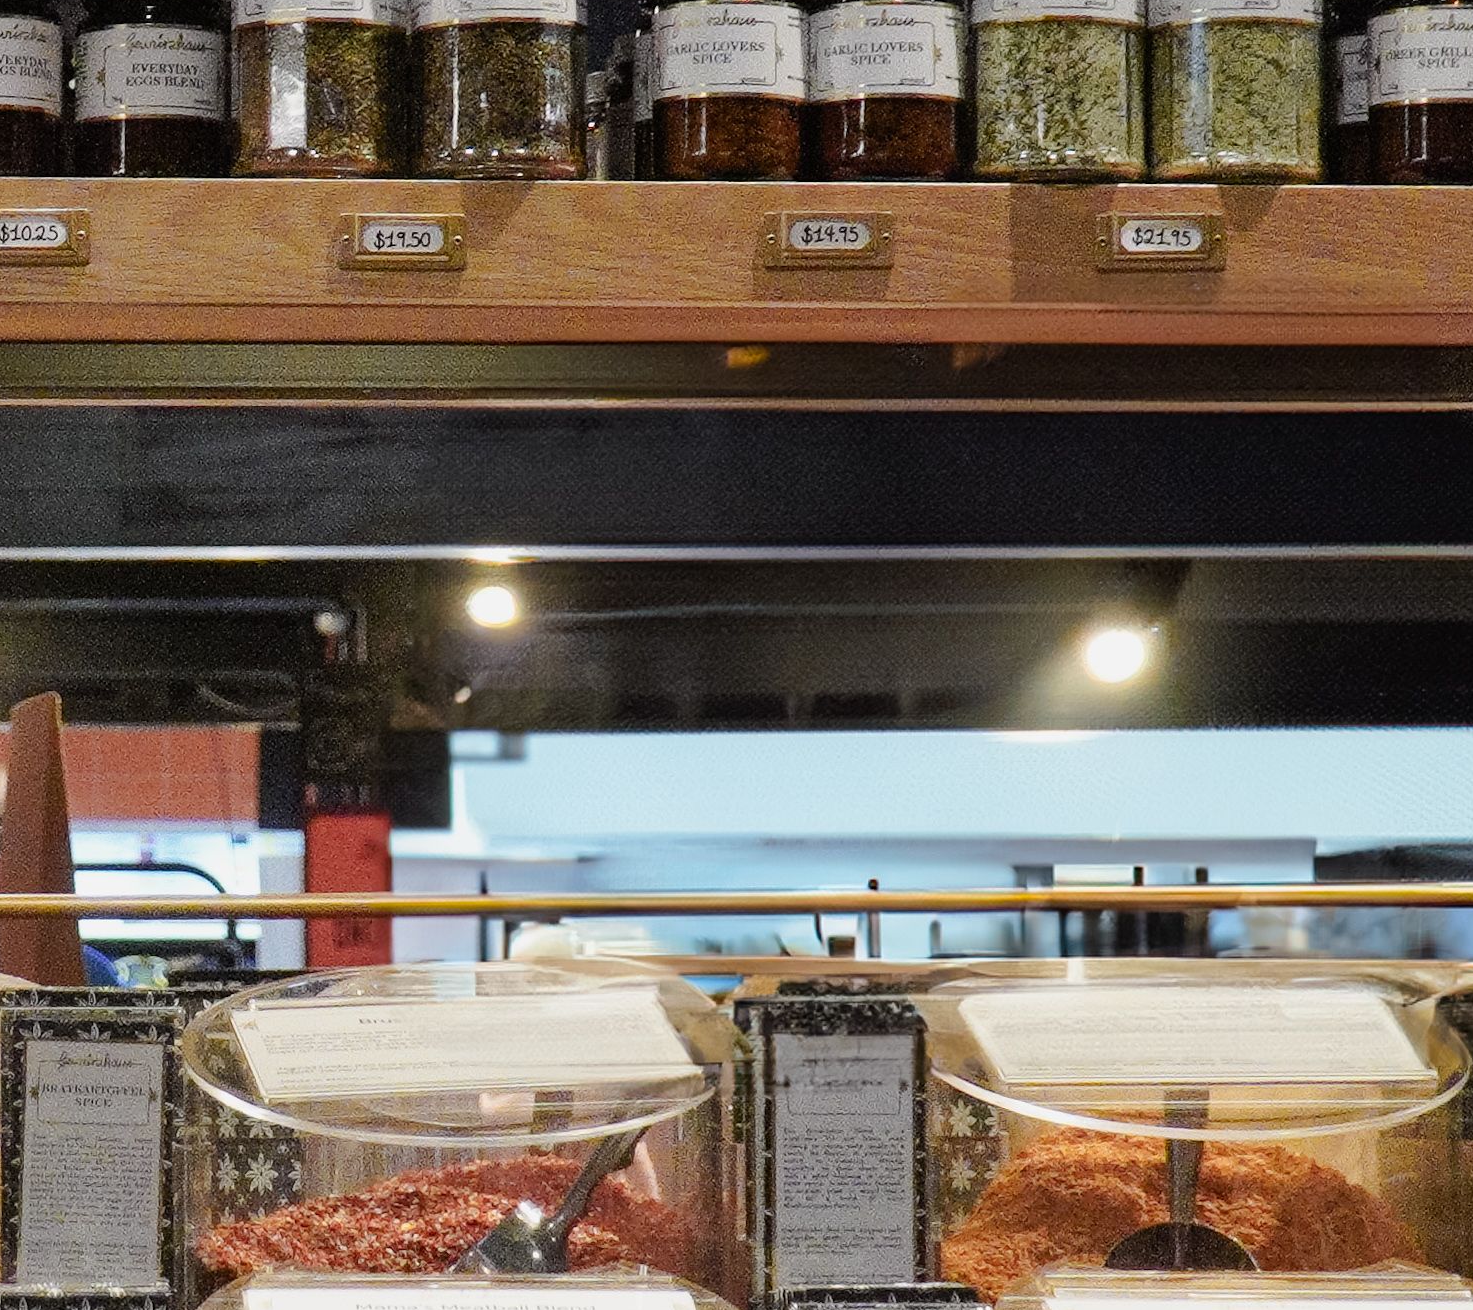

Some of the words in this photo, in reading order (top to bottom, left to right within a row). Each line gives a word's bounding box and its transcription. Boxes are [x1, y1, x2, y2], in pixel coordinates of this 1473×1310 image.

[712, 42, 766, 56] LOVERS
[691, 53, 733, 65] SPICE
[372, 232, 431, 250] $19.50
[800, 225, 859, 243] $14.95
[41, 1082, 145, 1096] BRATKARTOFFEL
[74, 1097, 113, 1109] SPICE
